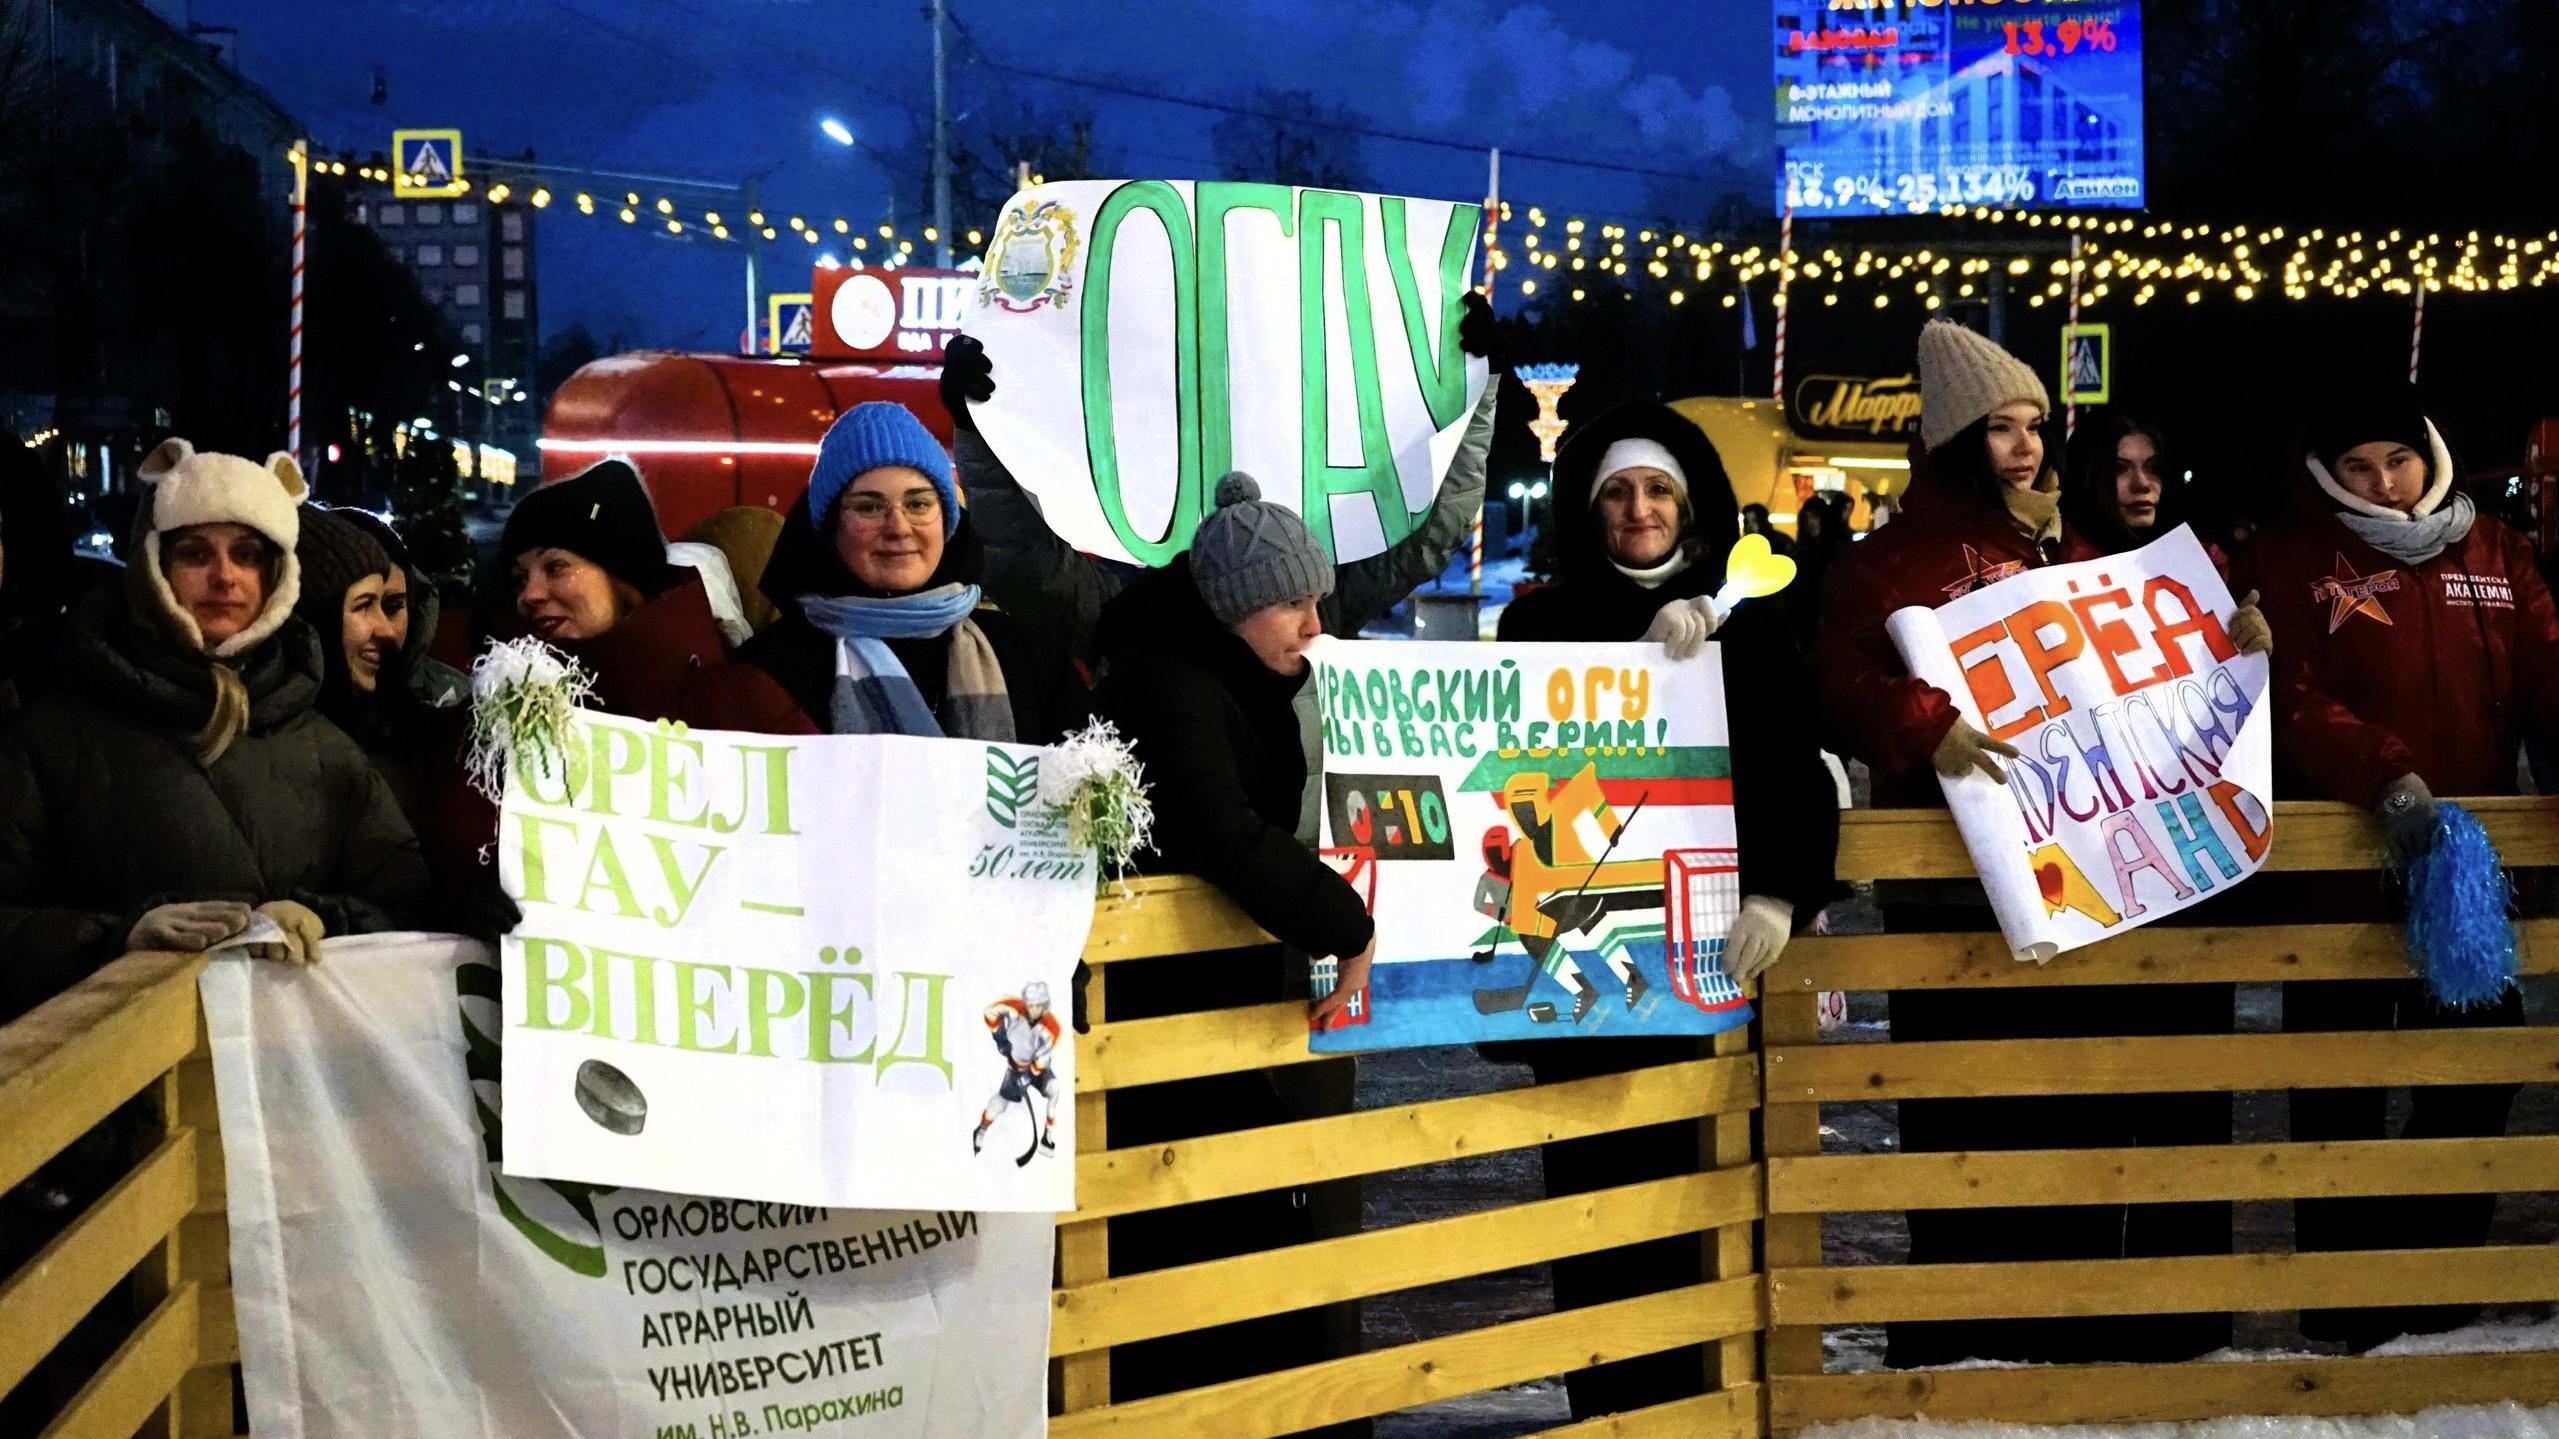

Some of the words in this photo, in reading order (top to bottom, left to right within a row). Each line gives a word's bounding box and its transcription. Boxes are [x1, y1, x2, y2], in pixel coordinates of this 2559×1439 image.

[1546, 664, 1651, 723] ОГУ
[511, 812, 727, 928] ГАУ
[968, 843, 1014, 878] 50
[1010, 860, 1085, 880] лет
[514, 936, 955, 1091] ВПЕРЁД
[642, 1290, 816, 1349] АГРАРНЫЙ
[648, 1332, 884, 1402] УНИВЕРСИТЕТ
[763, 1386, 904, 1432] Парахина
